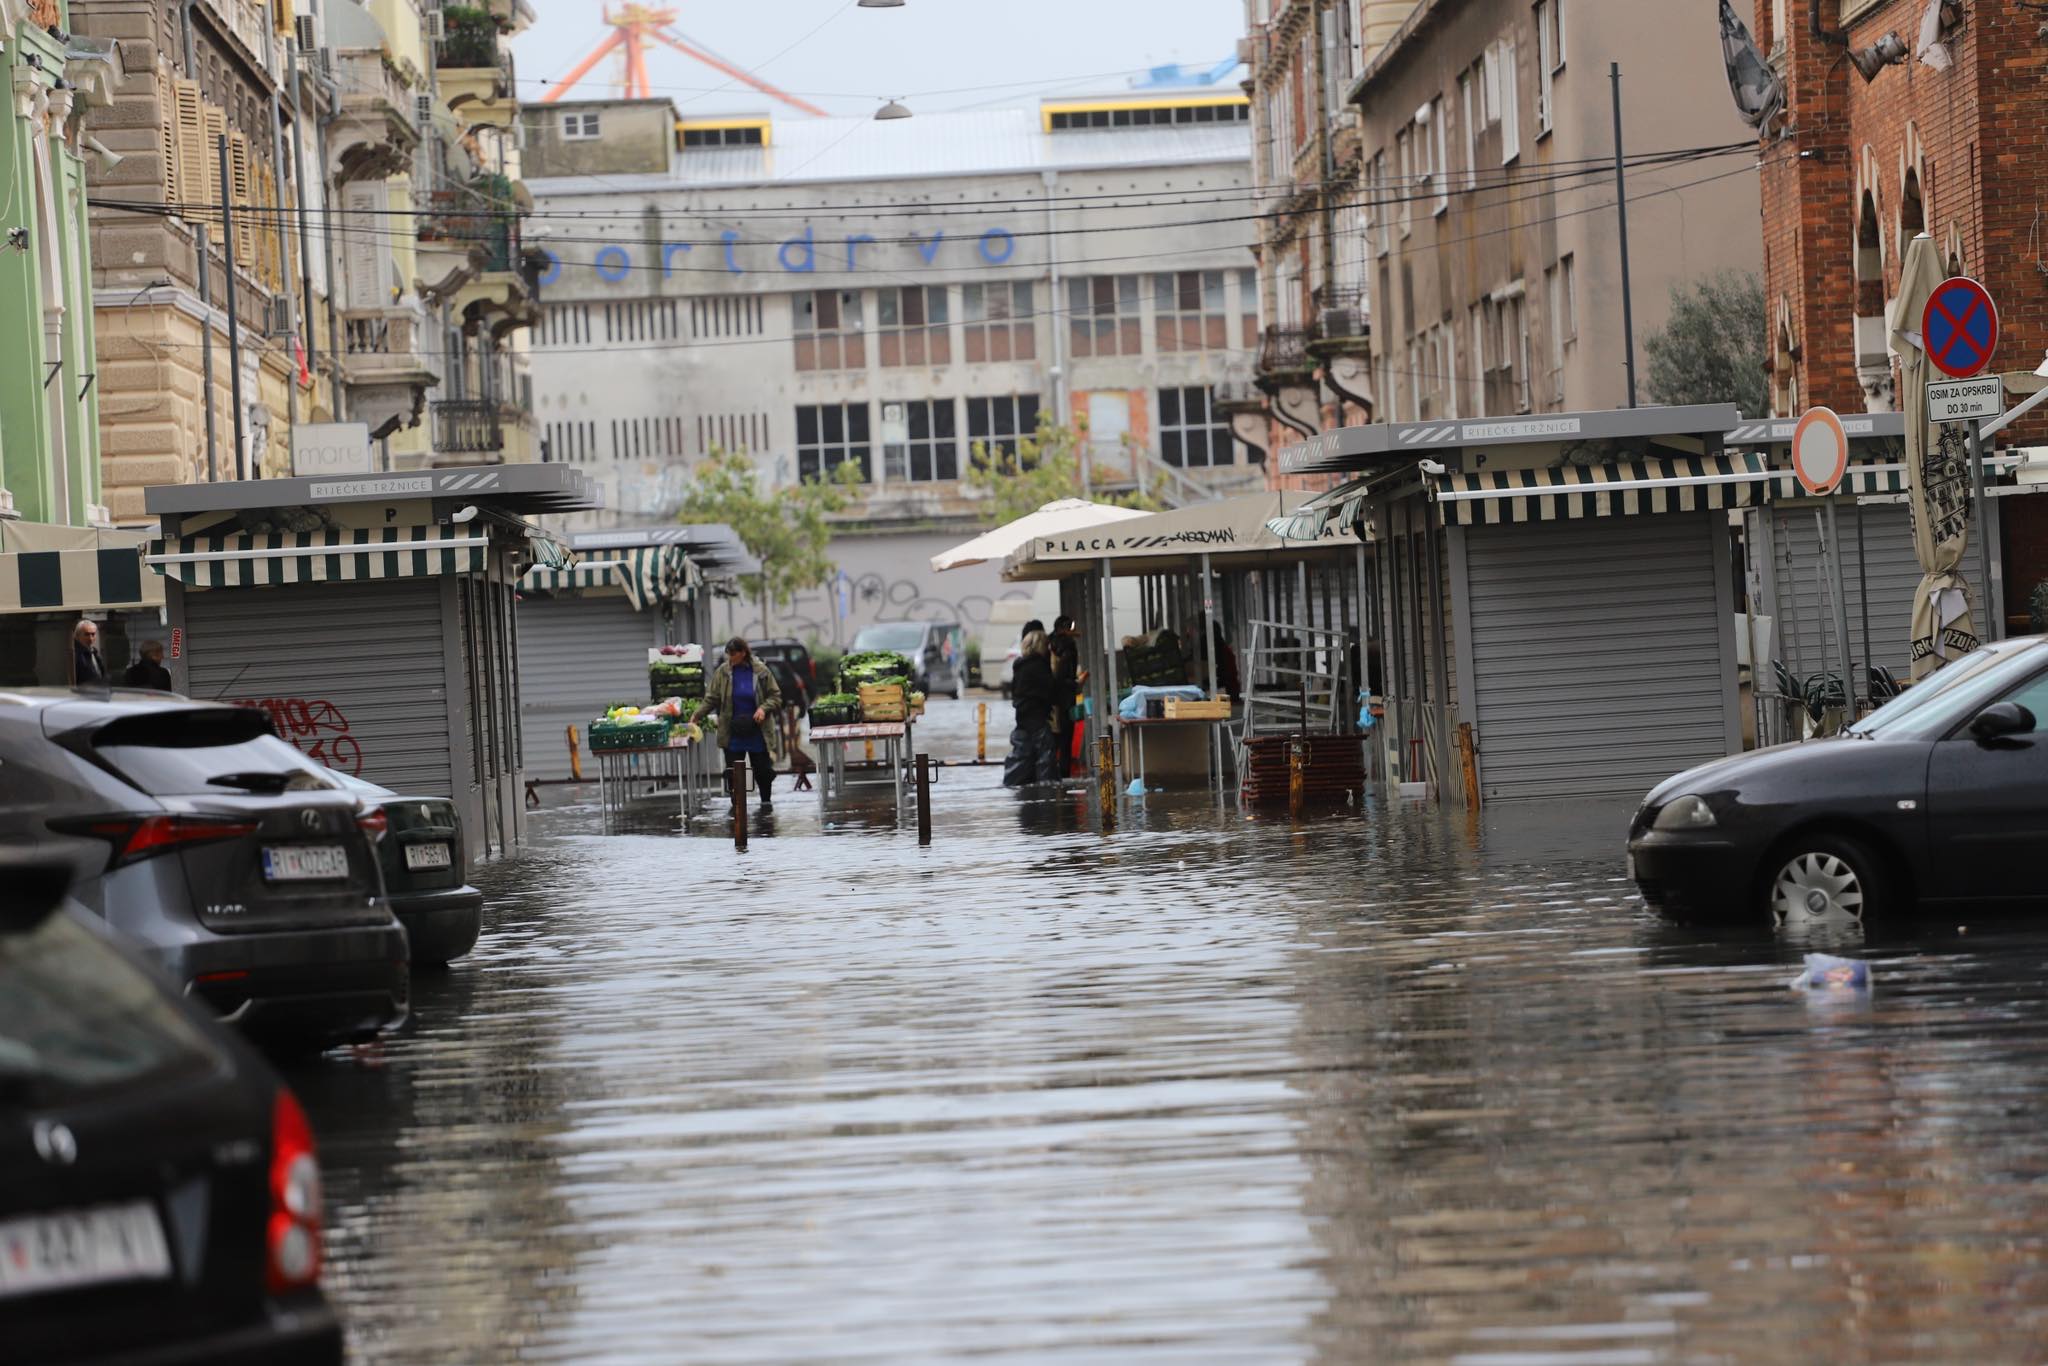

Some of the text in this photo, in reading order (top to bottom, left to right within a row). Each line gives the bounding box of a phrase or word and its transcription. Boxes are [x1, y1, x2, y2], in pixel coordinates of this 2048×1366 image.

[1930, 384, 1997, 400] OSIM ZA OPSKRBU
[1947, 402, 1982, 414] DO 30 min
[1468, 422, 1575, 437] RIJEČKE TRŽNICE
[1475, 454, 1487, 468] P
[316, 480, 428, 496] RIJEČKE TRŽNICE
[385, 508, 397, 522] P
[1046, 538, 1116, 552] PLACA
[172, 629, 181, 658] OMEGA
